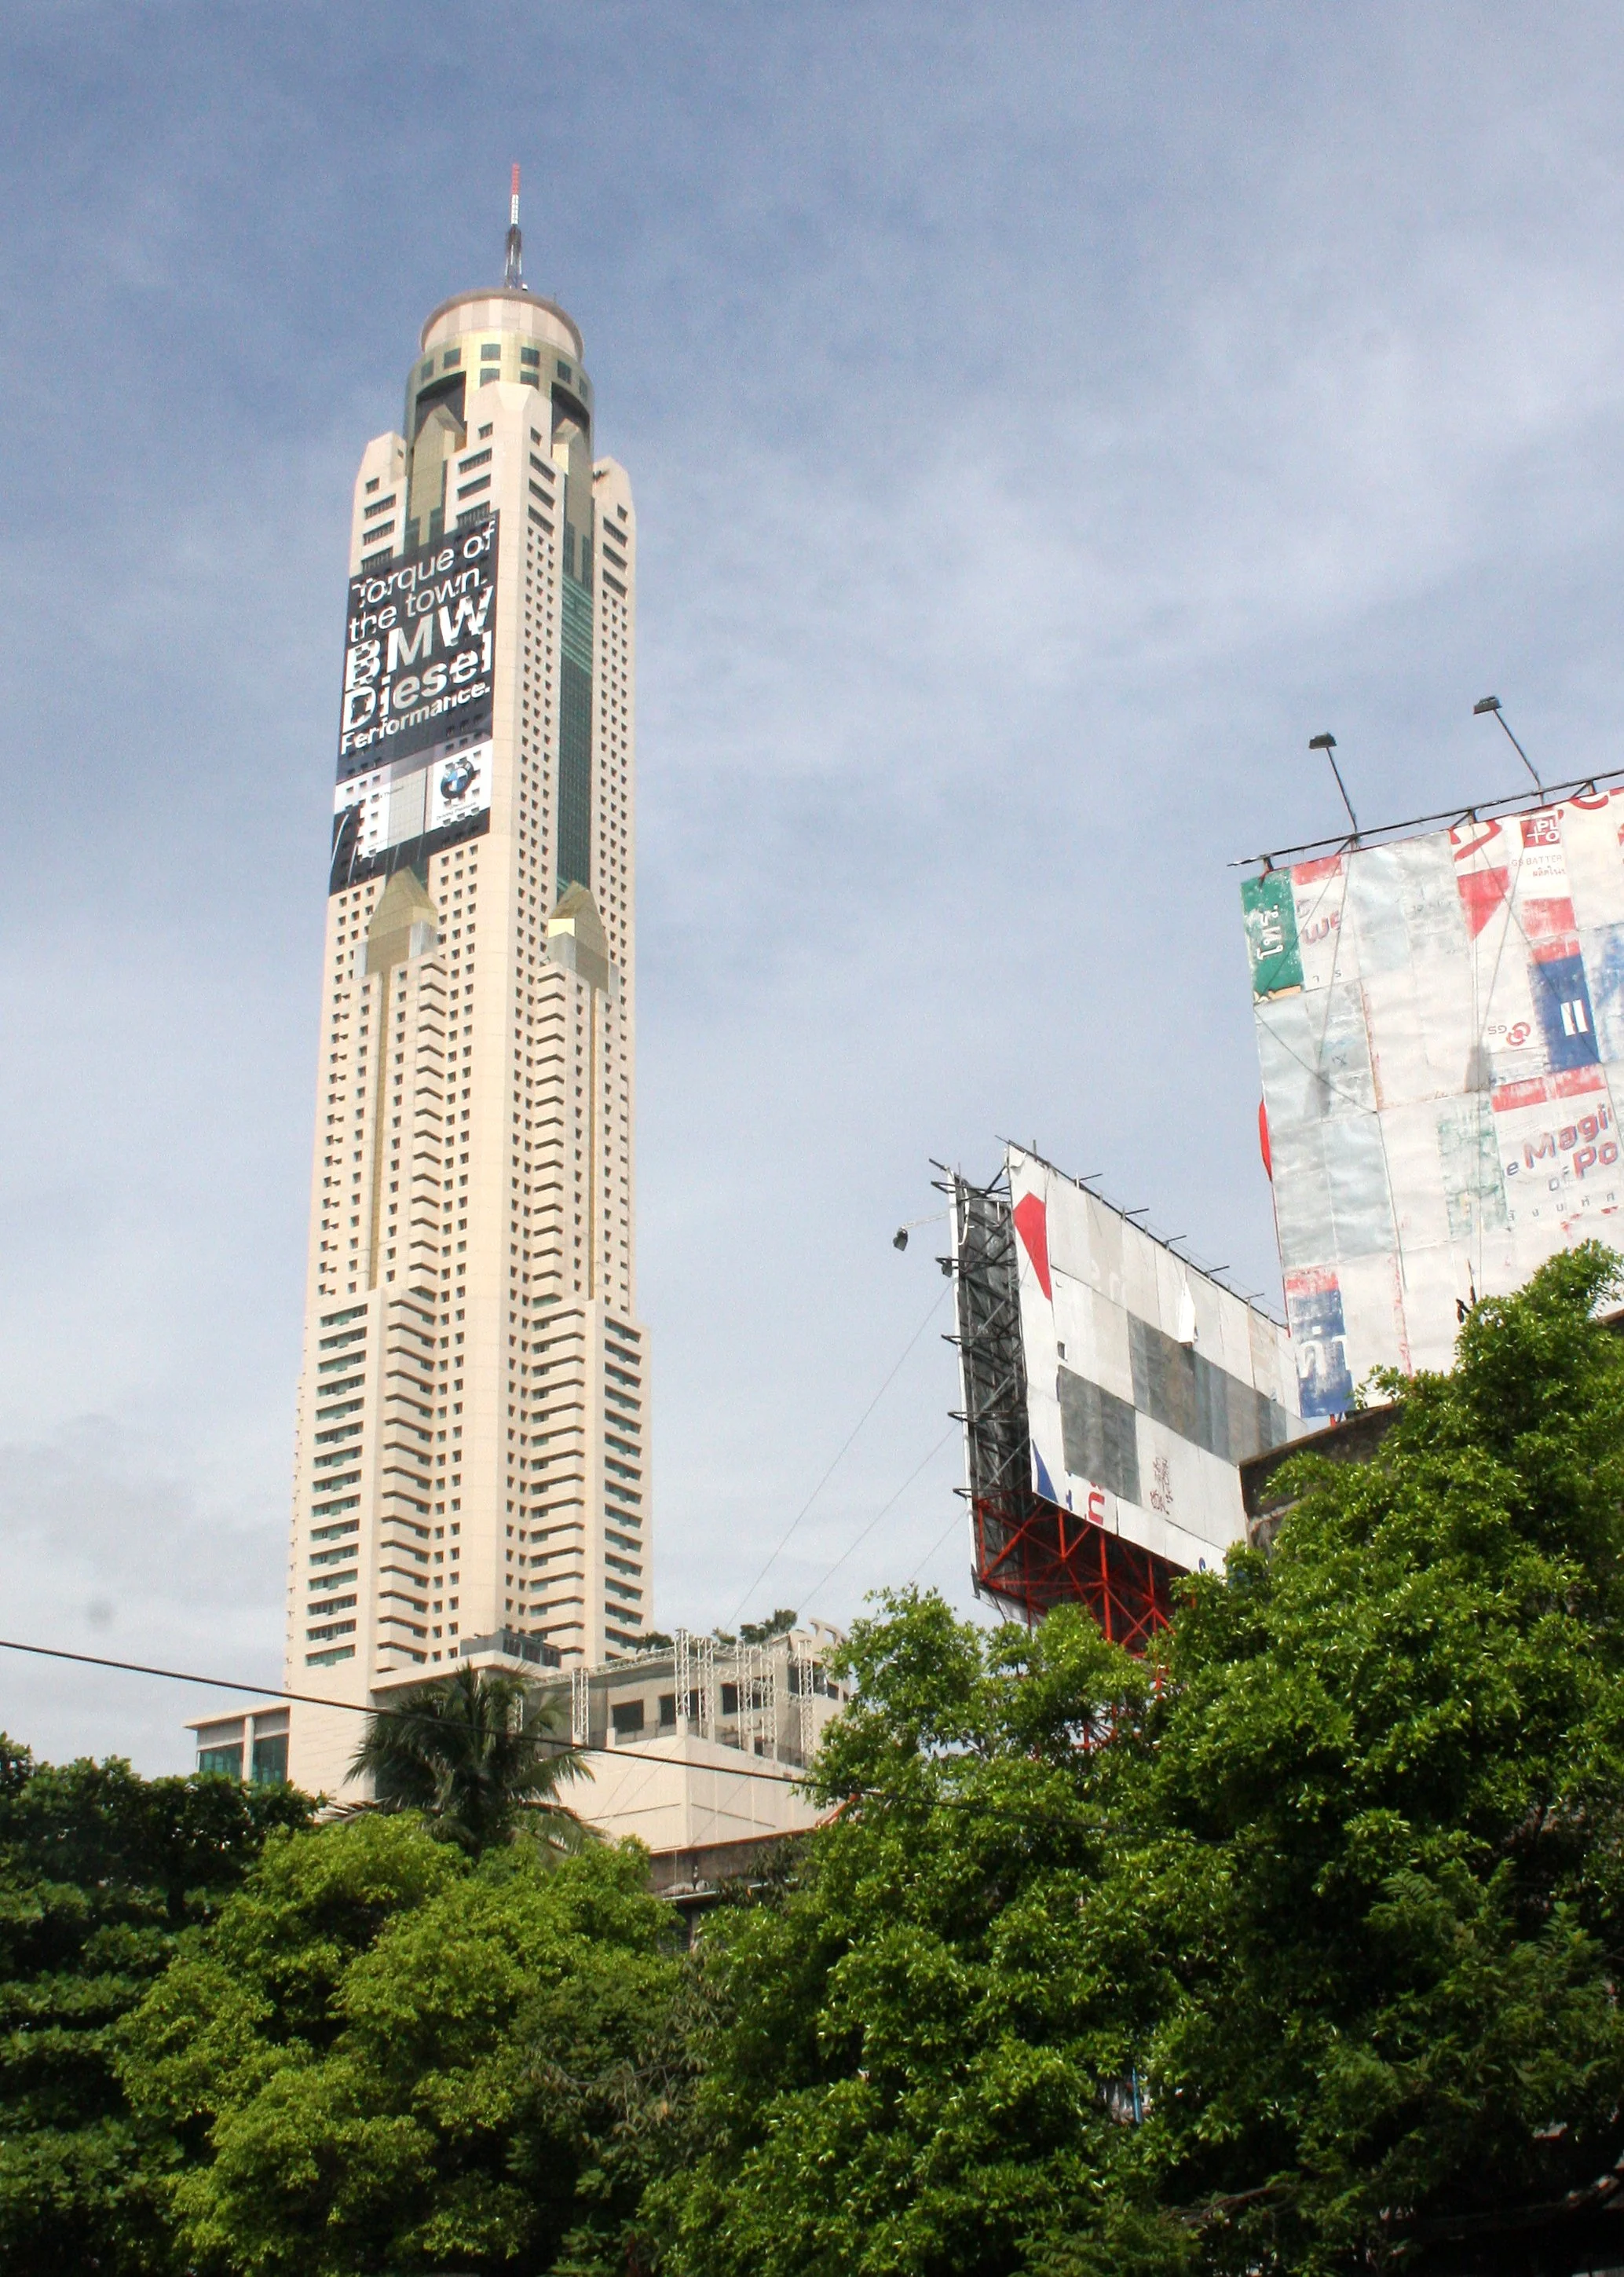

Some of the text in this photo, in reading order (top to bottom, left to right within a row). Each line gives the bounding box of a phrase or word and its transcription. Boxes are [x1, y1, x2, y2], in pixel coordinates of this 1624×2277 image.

[352, 520, 496, 608] Torque of
[345, 586, 493, 691] BMW
[349, 605, 397, 642] the
[342, 630, 492, 732] Diesel
[1523, 1103, 1614, 1170] Magi
